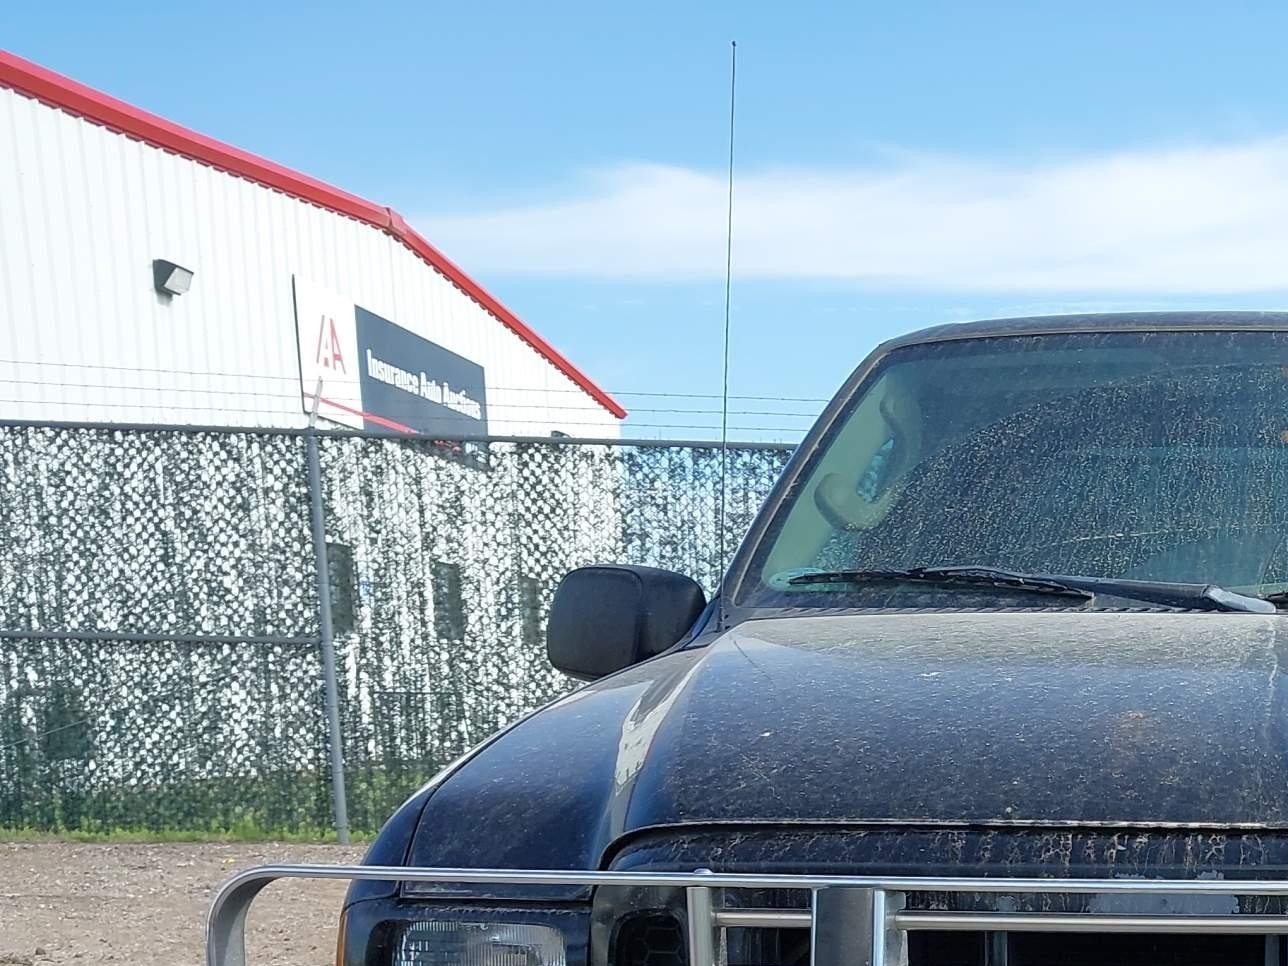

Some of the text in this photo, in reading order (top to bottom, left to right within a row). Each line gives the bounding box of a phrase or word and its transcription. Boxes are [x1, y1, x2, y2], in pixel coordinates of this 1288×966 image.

[366, 348, 482, 420] Insurance Auto Auctions
